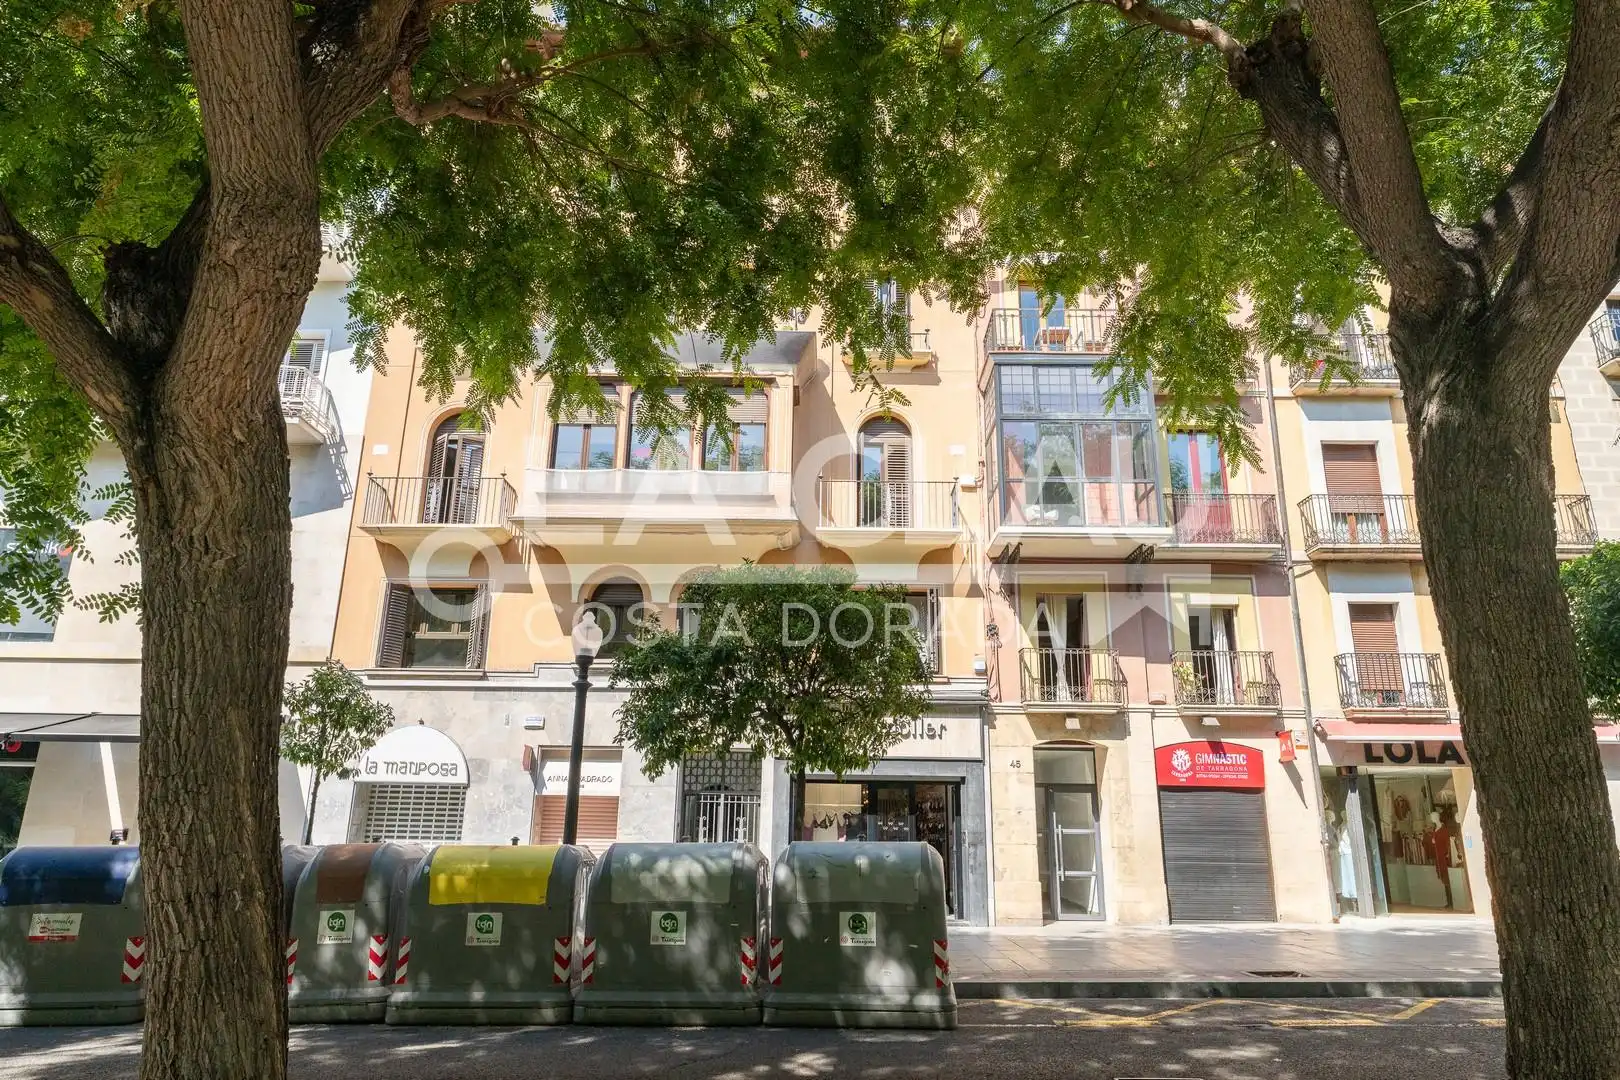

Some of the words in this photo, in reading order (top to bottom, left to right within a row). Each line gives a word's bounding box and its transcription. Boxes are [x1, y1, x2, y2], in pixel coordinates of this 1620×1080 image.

[1195, 751, 1248, 765] GIMNÀSTIC
[1363, 740, 1466, 764] LOLA
[364, 756, 378, 775] la
[383, 760, 458, 777] mariposa
[1009, 760, 1022, 769] 45
[546, 775, 569, 783] ANNA
